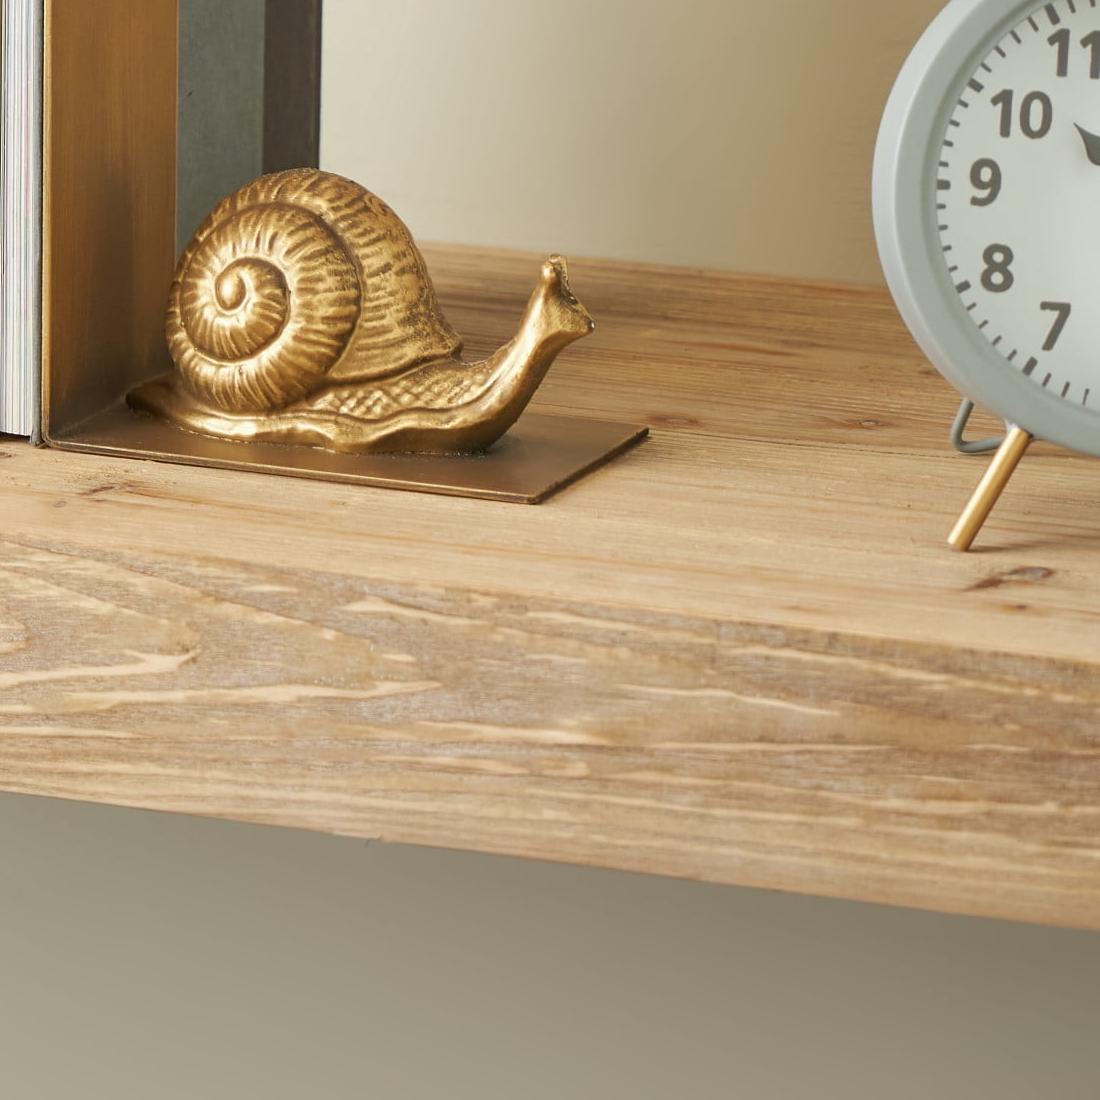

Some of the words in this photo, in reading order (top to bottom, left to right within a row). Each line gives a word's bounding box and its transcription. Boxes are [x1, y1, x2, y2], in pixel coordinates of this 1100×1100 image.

[1046, 27, 1100, 80] 11
[990, 88, 1053, 140] 10
[969, 157, 1002, 208] 9
[980, 243, 1015, 294] 8
[1039, 301, 1072, 352] 7
